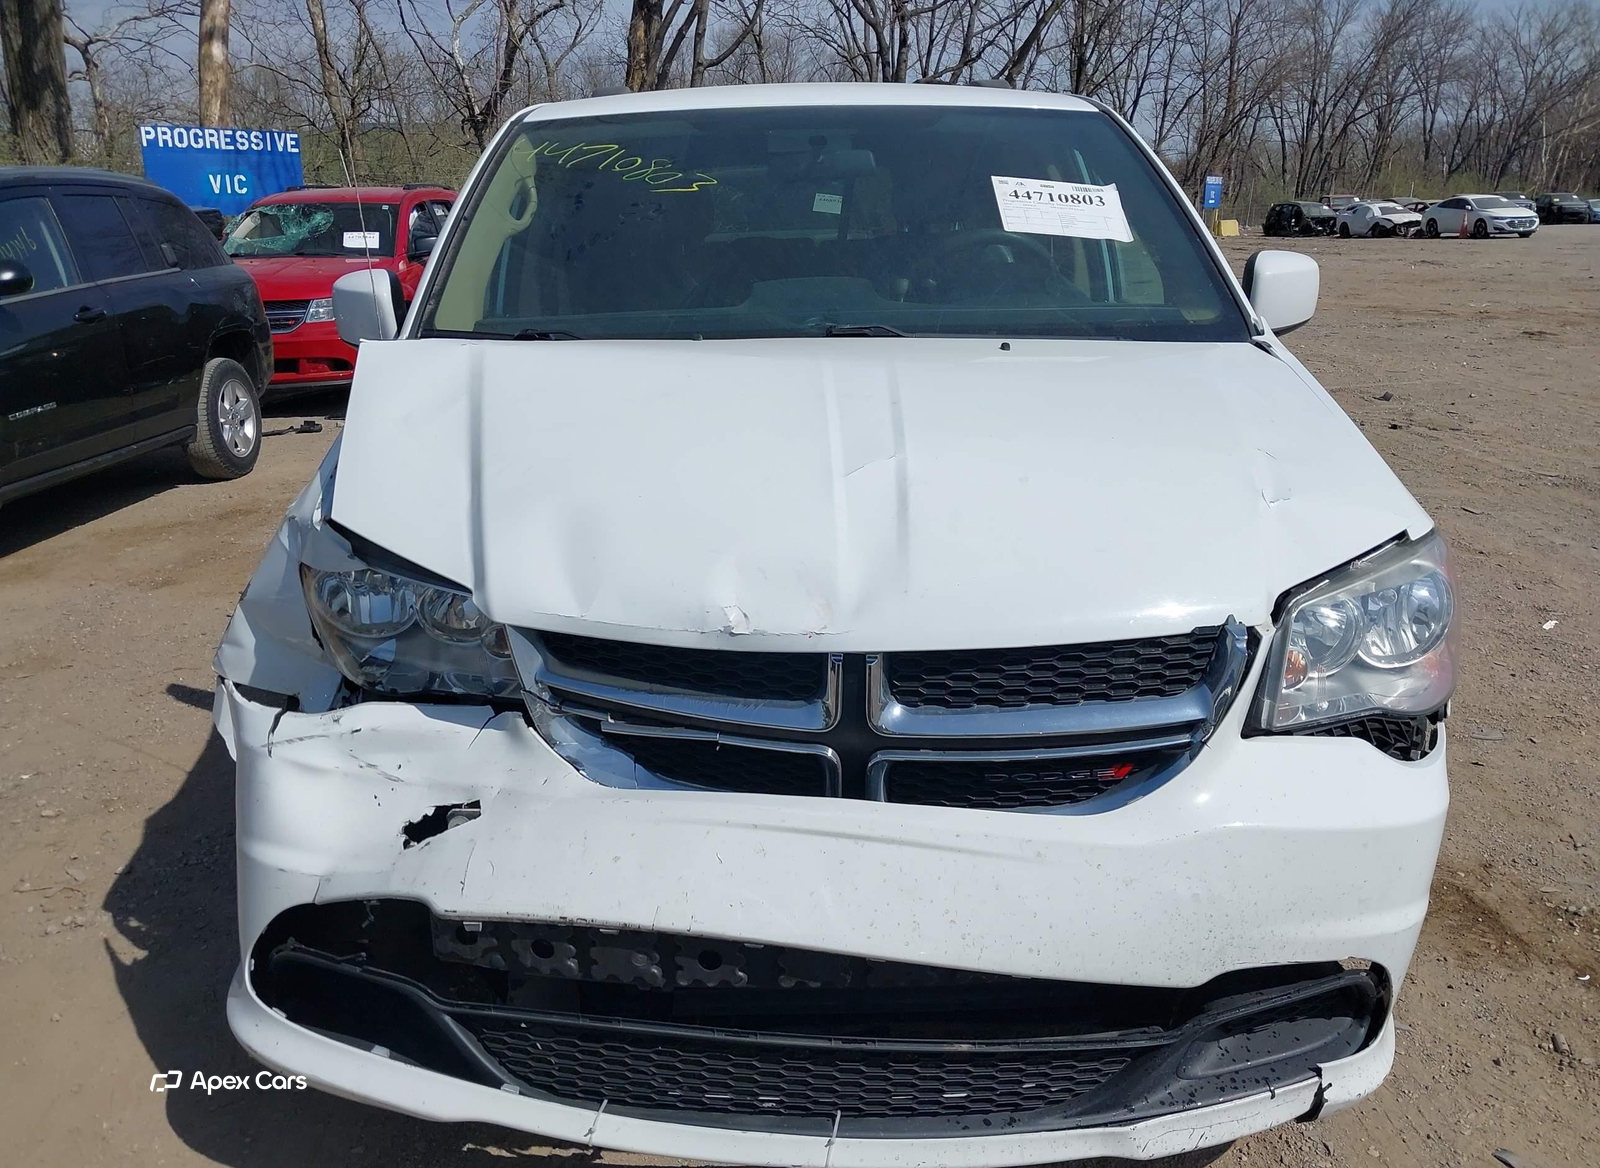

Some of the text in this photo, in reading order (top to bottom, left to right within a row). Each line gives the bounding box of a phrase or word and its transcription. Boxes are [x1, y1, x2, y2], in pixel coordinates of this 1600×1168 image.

[140, 126, 300, 153] PROGRESSIVE
[513, 138, 718, 193] 44710803
[208, 174, 249, 195] VIC
[1008, 189, 1106, 207] 44710803
[984, 768, 1116, 782] DODGE
